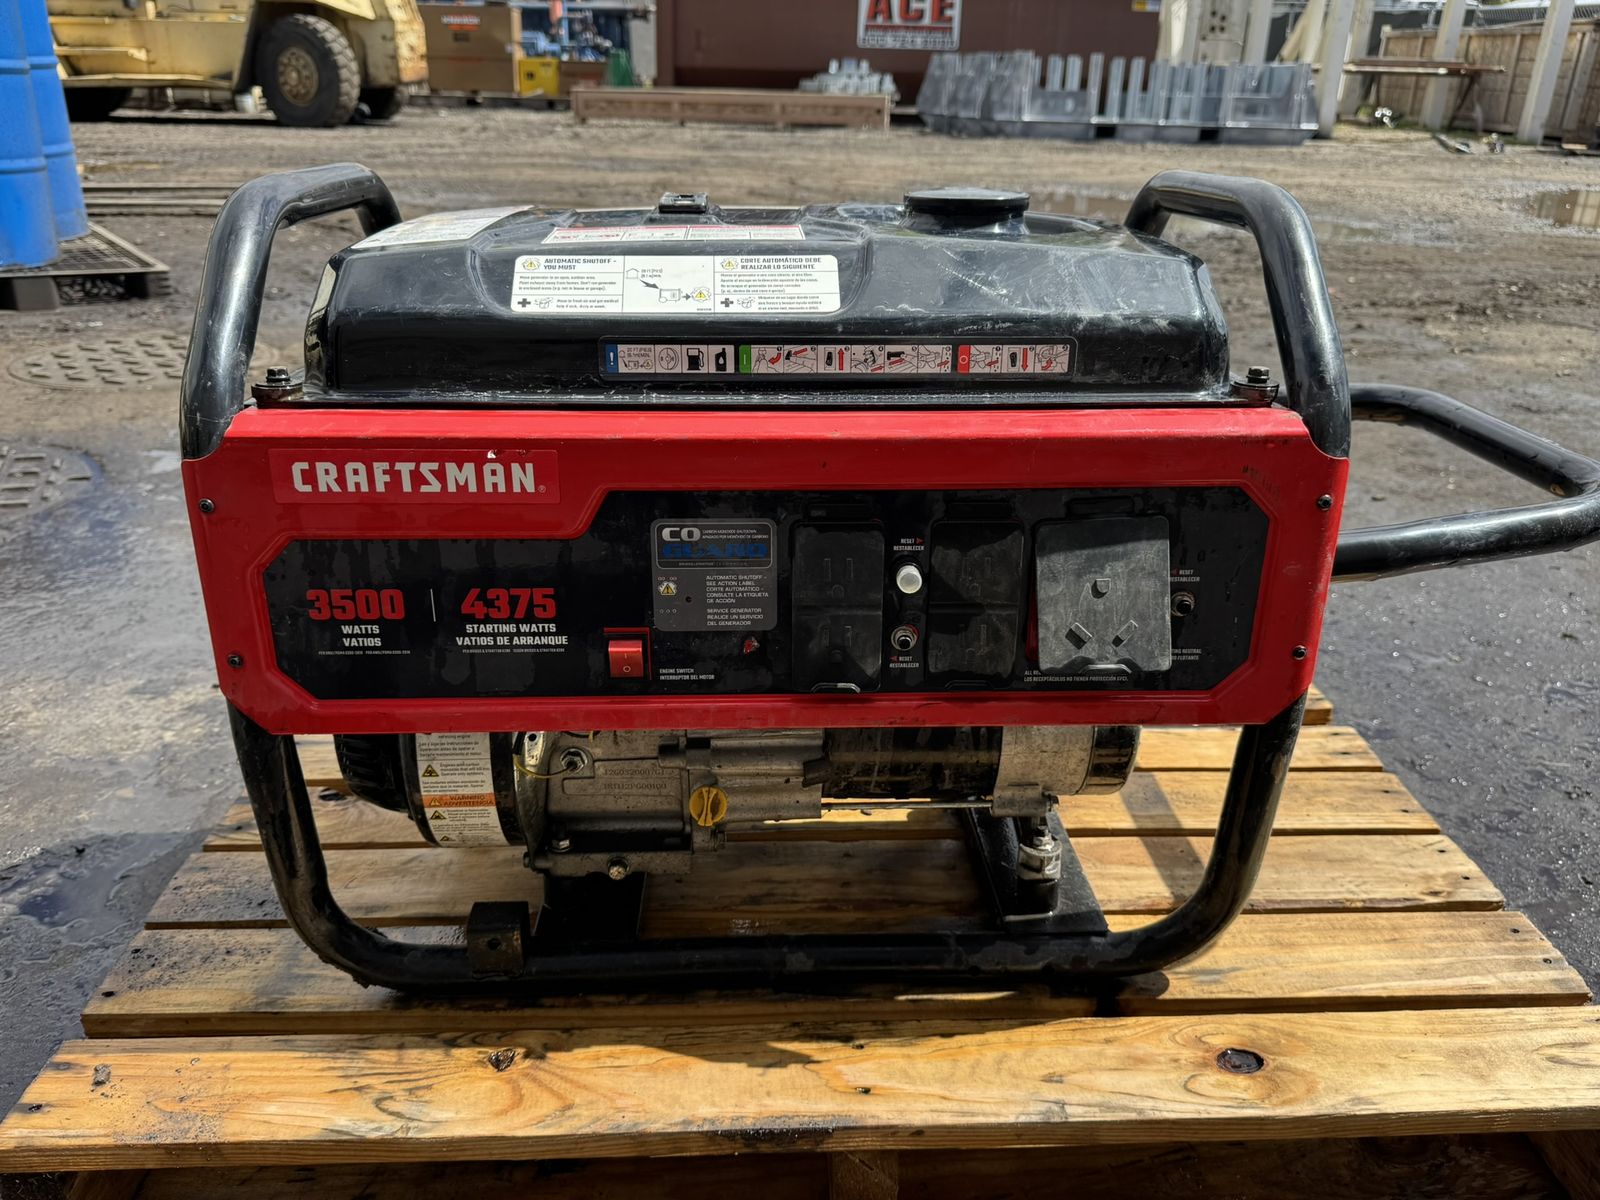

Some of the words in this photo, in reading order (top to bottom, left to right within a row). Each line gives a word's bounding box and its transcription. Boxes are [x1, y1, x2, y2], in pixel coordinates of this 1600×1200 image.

[867, 0, 953, 22] ACE
[291, 461, 536, 493] CRAFTSMAN
[662, 527, 700, 541] CO
[662, 543, 768, 558] GUARD
[305, 588, 405, 620] 3500
[461, 588, 556, 620] 4375
[341, 625, 380, 634] WATTS
[465, 624, 517, 633] STARTING
[519, 624, 556, 633] WATTS
[342, 637, 381, 647] VATIOS
[456, 636, 494, 646] VATIOS
[496, 636, 510, 646] DE
[512, 636, 568, 646] ARRANQUE
[443, 799, 494, 807] ADVERTENCIA
